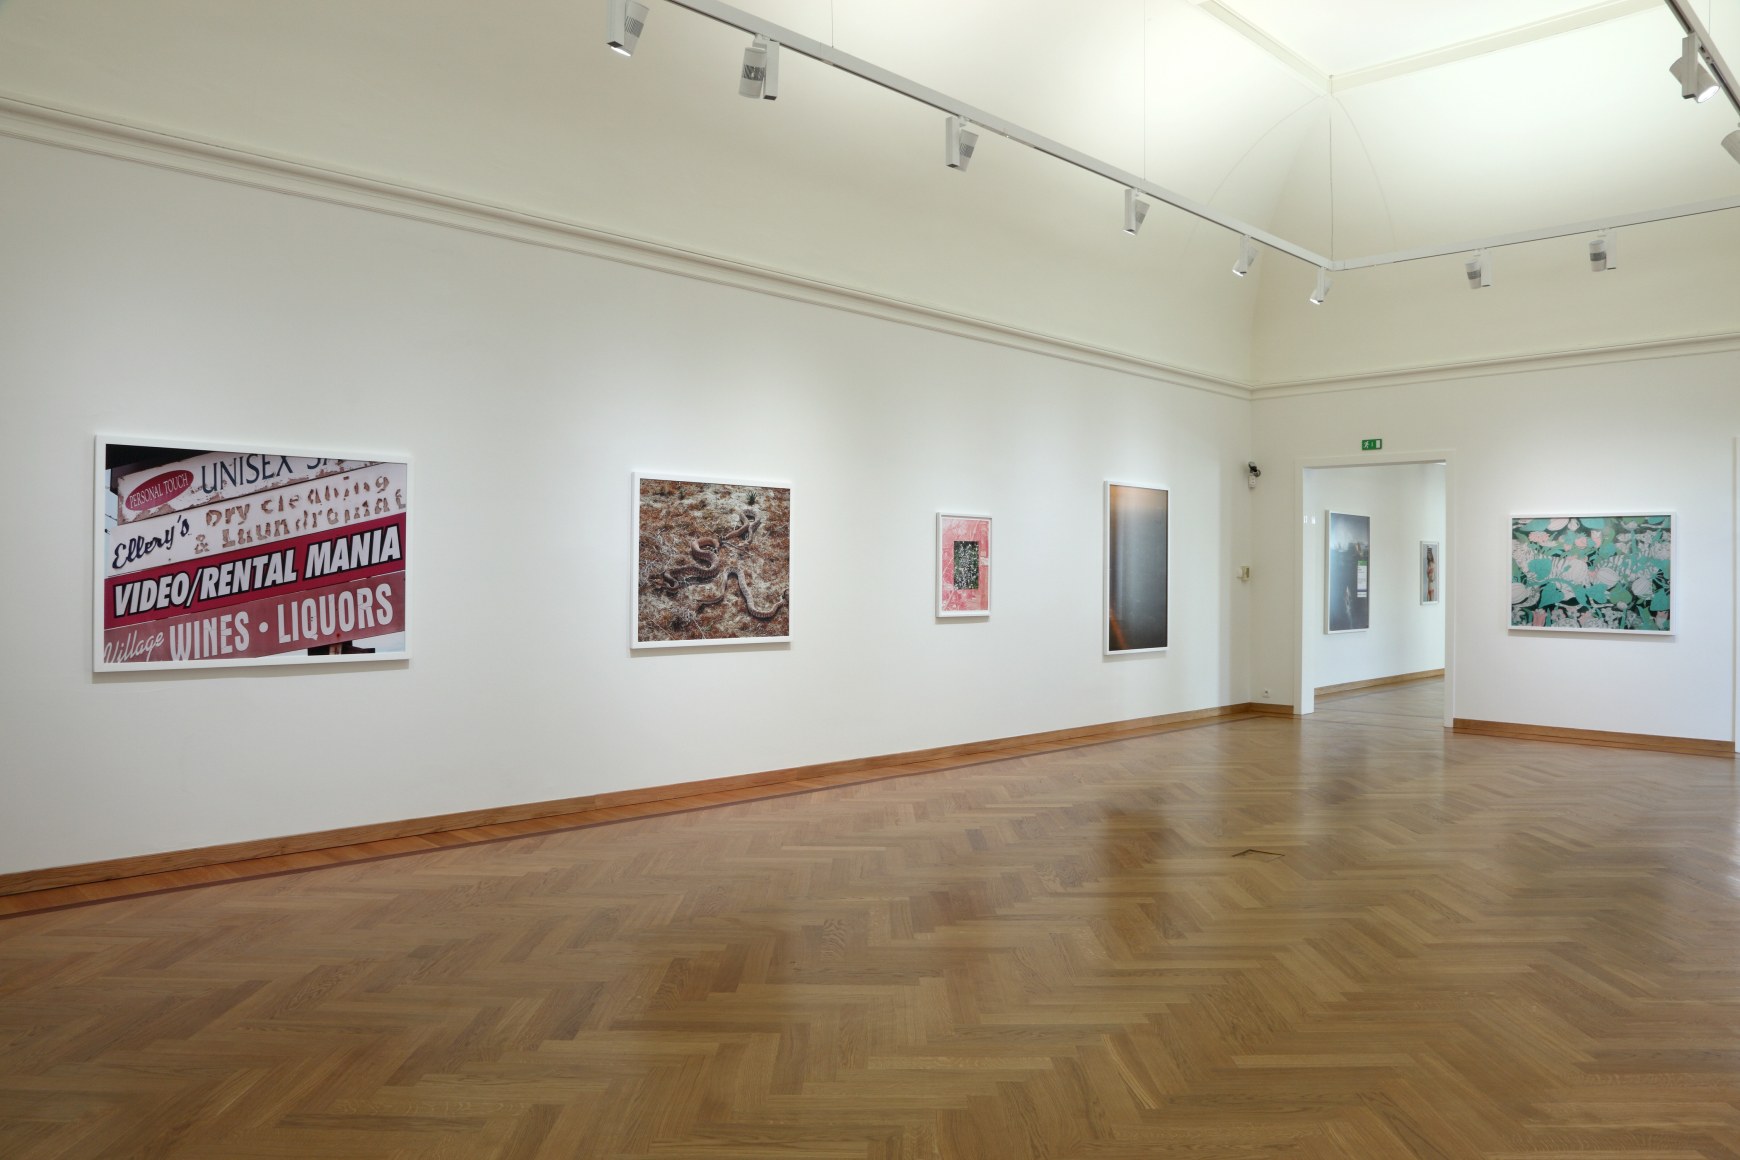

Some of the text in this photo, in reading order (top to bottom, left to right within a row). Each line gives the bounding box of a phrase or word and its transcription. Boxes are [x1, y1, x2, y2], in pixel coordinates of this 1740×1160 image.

[129, 473, 189, 509] PERSONAL TOUCH
[202, 454, 293, 493] UNISEX
[206, 503, 250, 526] Dry
[112, 515, 190, 569] Ellery's
[114, 526, 401, 618] VIDEO/RENTAL MANIA
[104, 583, 394, 663] Village WINES LIQUORS
